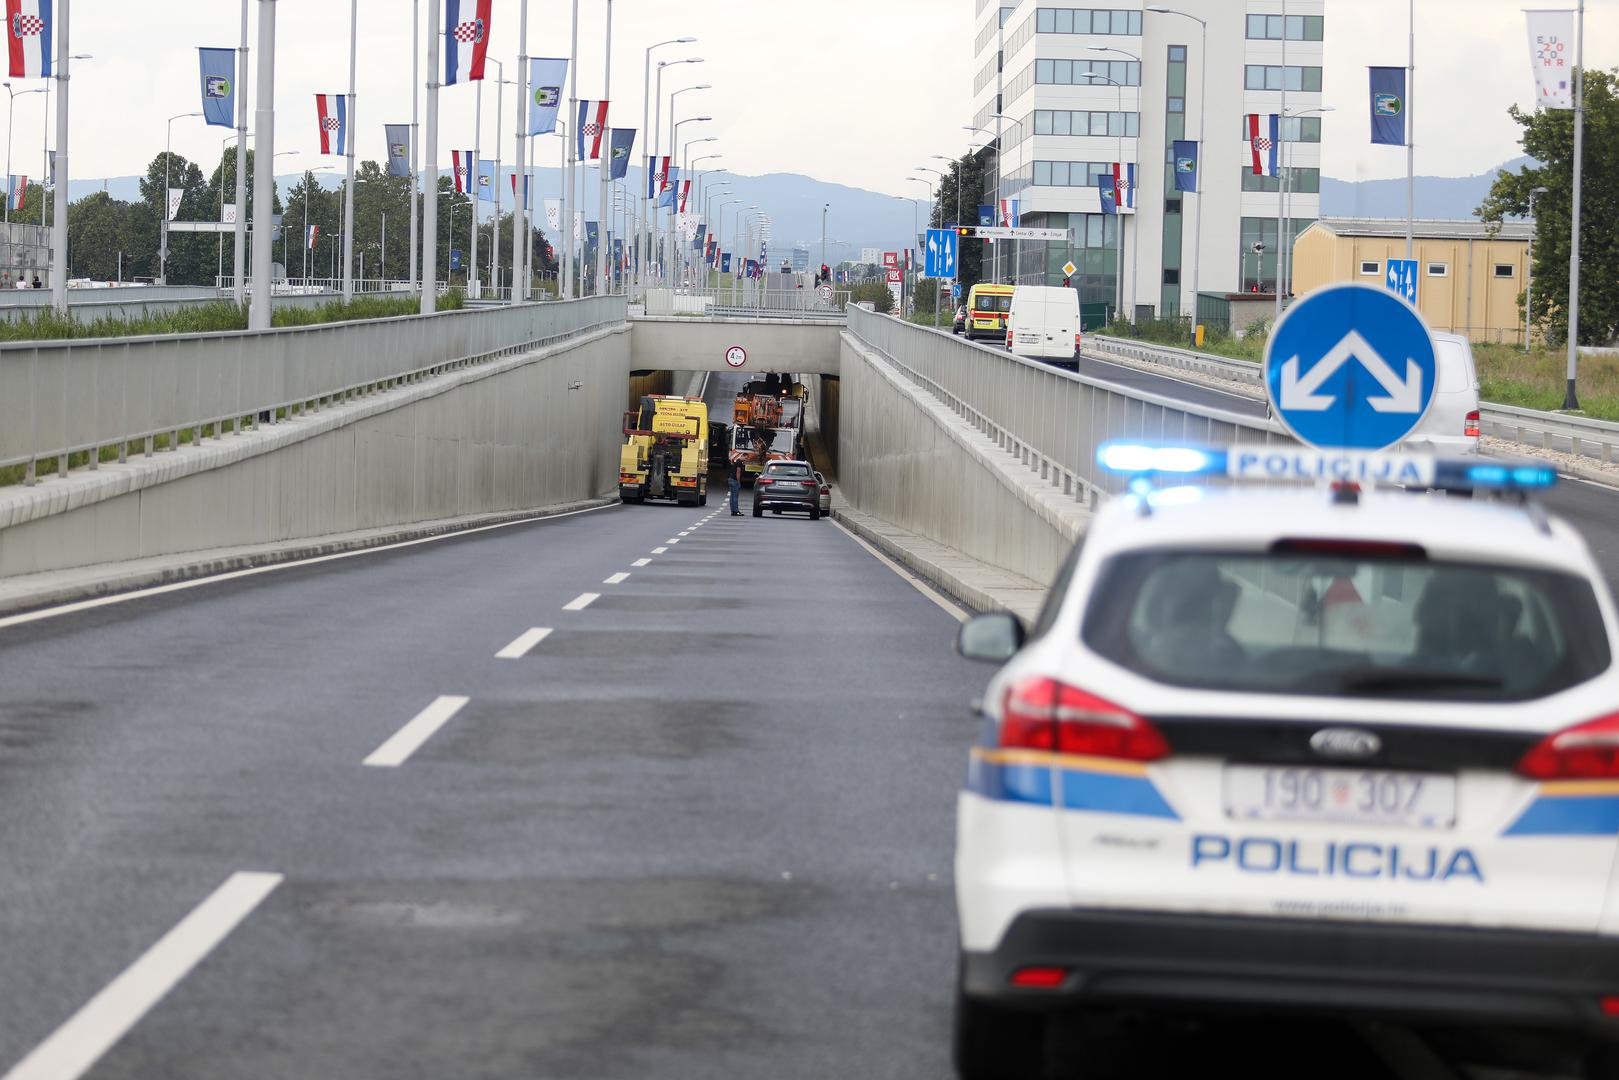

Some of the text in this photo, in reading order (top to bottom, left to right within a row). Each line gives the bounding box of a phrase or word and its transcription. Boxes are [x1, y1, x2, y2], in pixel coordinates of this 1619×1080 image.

[1239, 453, 1421, 481] POLICIJA
[1359, 770, 1424, 815] 307
[1191, 833, 1485, 883] POLICIJA
